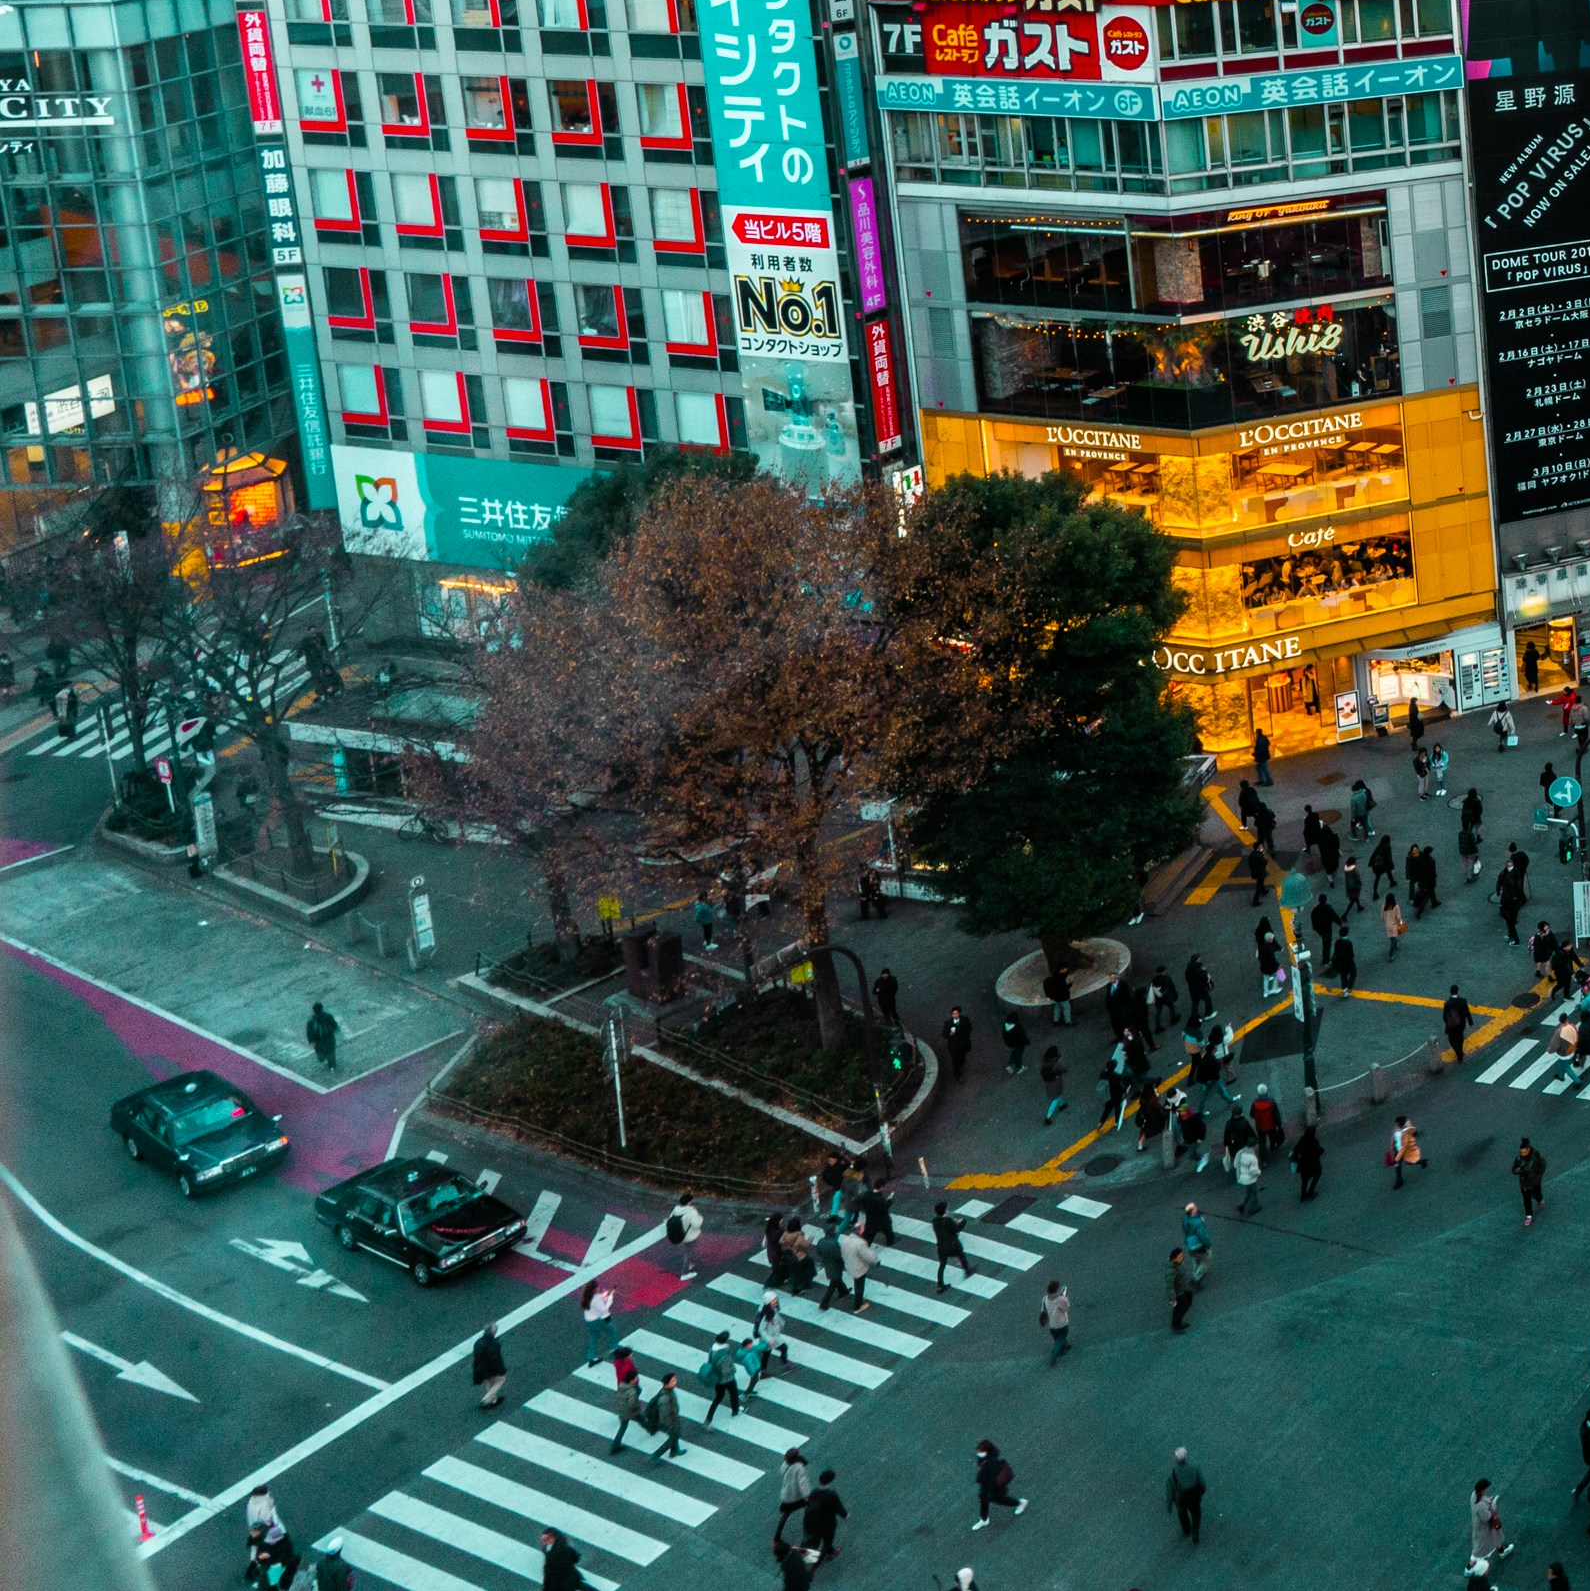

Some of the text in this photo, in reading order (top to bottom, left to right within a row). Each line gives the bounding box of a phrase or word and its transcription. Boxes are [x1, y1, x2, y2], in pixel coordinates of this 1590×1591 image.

[244, 13, 267, 72] 外貨両替
[883, 23, 922, 54] 7F
[933, 24, 978, 47] Café
[983, 19, 1090, 71] ガスト
[935, 49, 978, 63] レストラン
[1110, 39, 1145, 56] ガスト
[886, 82, 1139, 112] AEON 英会話イーオン 6F
[1173, 65, 1455, 109] AEON 英会話イーオン
[1495, 84, 1576, 112] 星野源
[0, 97, 112, 118] CITY
[1499, 134, 1543, 185] NEW ALBUM
[262, 149, 296, 242] 加藤眼科
[1523, 197, 1551, 227] NOW
[1549, 178, 1567, 199] ON
[744, 222, 822, 244] 当ビル5階
[278, 250, 297, 262] 5F
[750, 253, 814, 273] 利用者数
[858, 202, 882, 308] 品川美容外科 4F
[1492, 256, 1530, 271] DOME
[1534, 251, 1566, 265] TOUR
[734, 274, 842, 339] No.1
[1514, 309, 1589, 330] 京セラドーム大阪
[740, 337, 843, 358] コンタクトショップ
[872, 324, 890, 387] 外貨両替
[1527, 350, 1583, 368] ナゴヤドーム
[1534, 390, 1581, 408] 札幌ドーム
[296, 363, 327, 476] 三井住友信託銀行
[883, 439, 898, 450] 7F
[1264, 435, 1343, 456] EN PROVENCE
[1538, 431, 1584, 447] 東京ドーム
[1080, 449, 1126, 461] PROVENCE
[1288, 526, 1335, 548] Café
